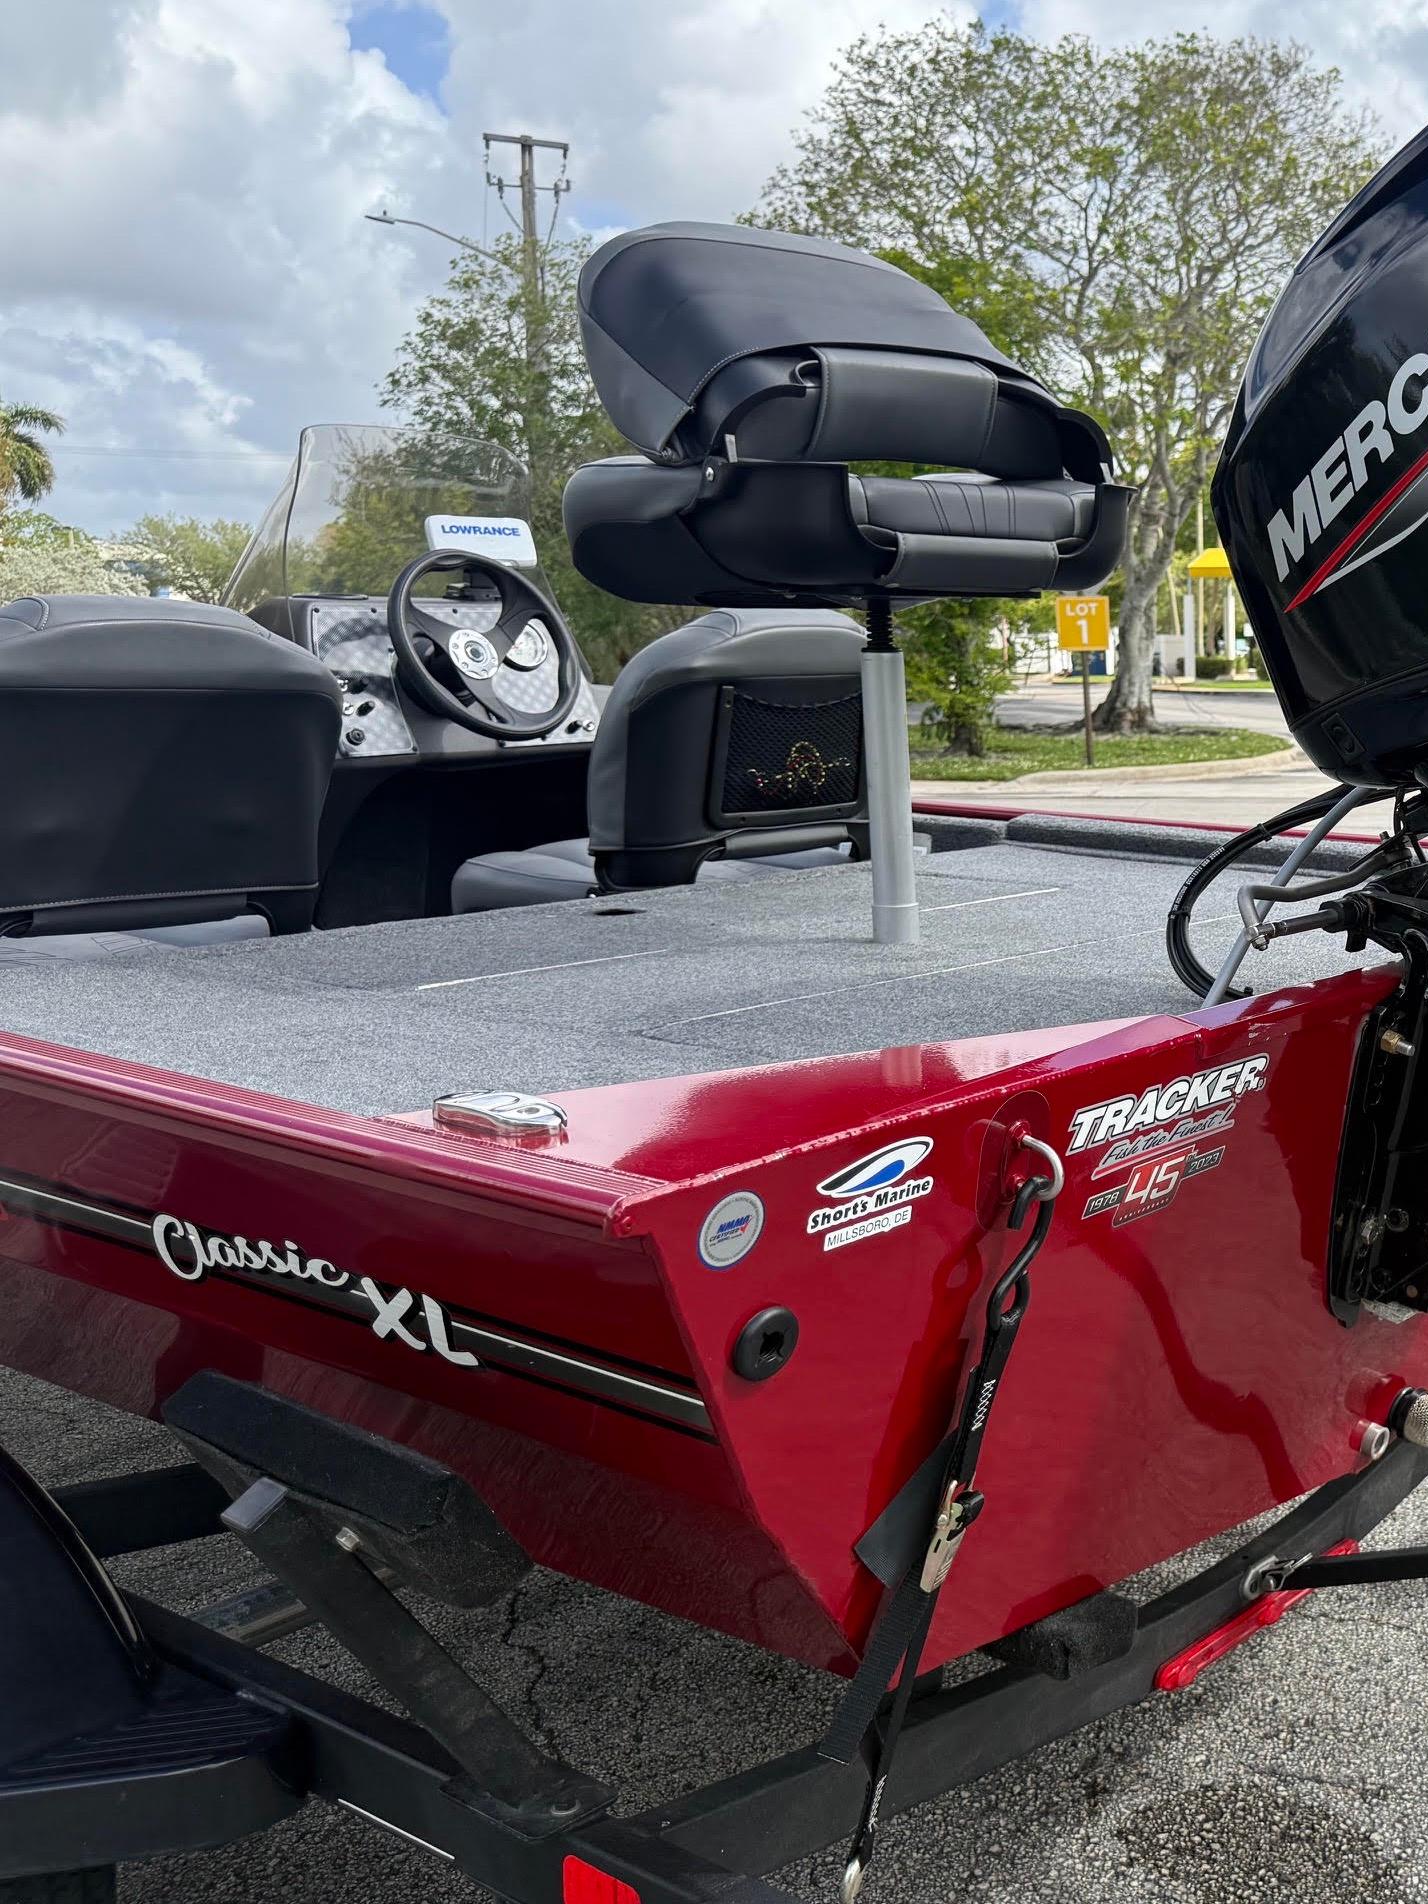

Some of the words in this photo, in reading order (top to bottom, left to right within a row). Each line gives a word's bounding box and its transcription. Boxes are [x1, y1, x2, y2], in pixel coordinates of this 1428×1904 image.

[441, 525, 521, 536] LOWRANCE
[1065, 602, 1099, 617] LOT
[1076, 620, 1088, 645] 1
[1069, 1057, 1267, 1150] TRACKER
[1103, 1138, 1140, 1165] Fish
[1143, 1130, 1165, 1149] the
[1090, 1191, 1119, 1211] 1978
[1189, 1152, 1220, 1173] 2023
[811, 1200, 868, 1230] Short's
[874, 1180, 930, 1208] Marine
[827, 1216, 891, 1248] MILLSBORO,
[895, 1210, 909, 1223] DE
[153, 1214, 349, 1287] Classic
[360, 1277, 479, 1367] XL
